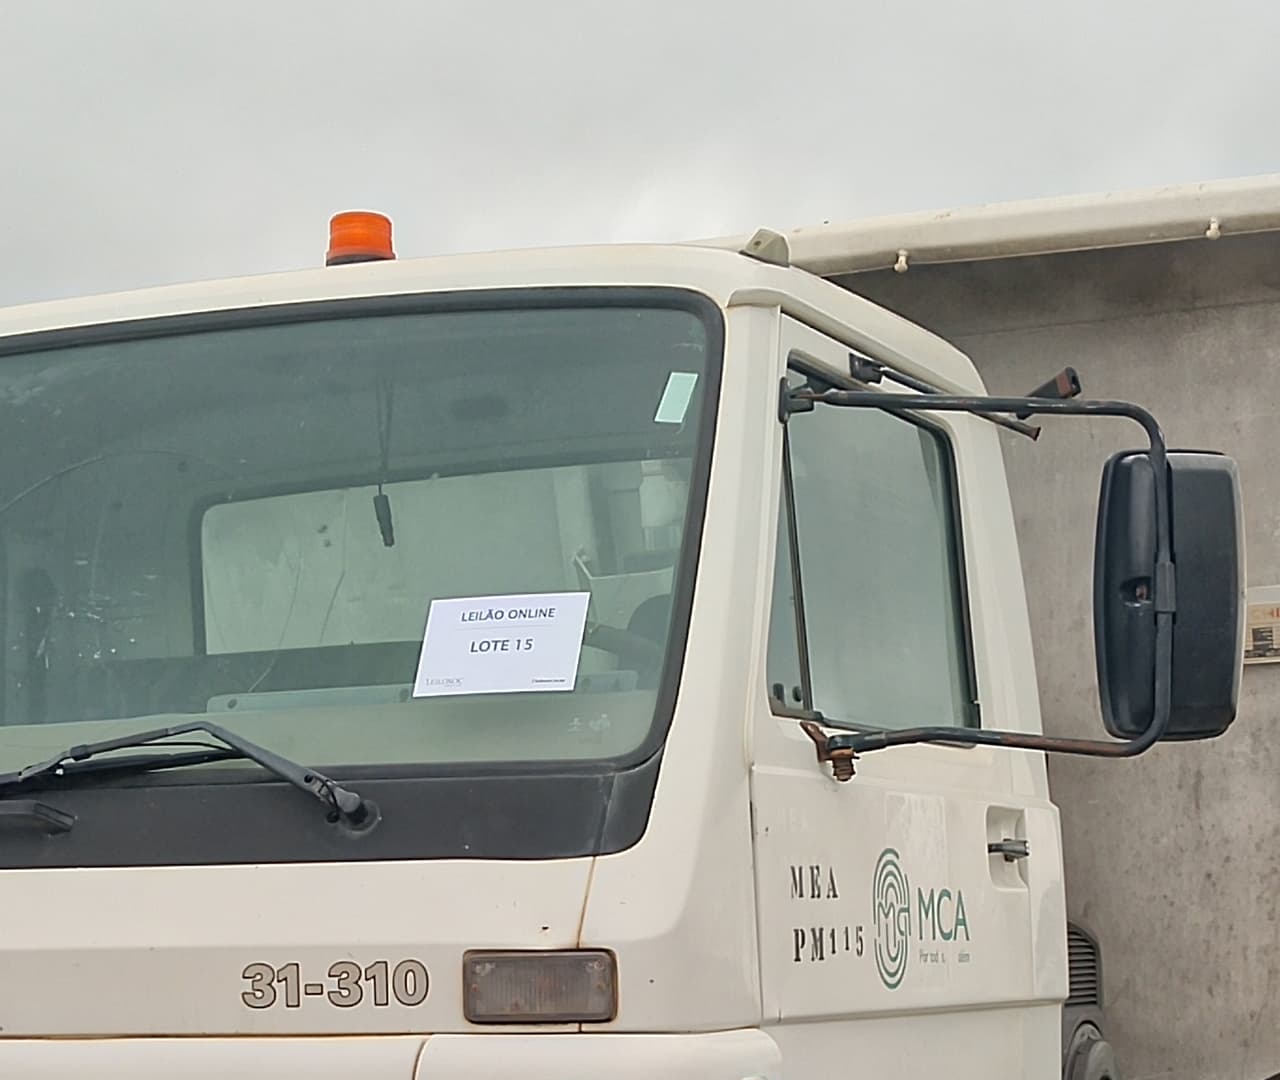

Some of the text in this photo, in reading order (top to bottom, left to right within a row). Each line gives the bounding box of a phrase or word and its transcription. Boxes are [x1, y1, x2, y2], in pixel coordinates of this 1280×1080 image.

[461, 607, 556, 622] LEILÃO ONLINE
[470, 638, 534, 653] LOTE 15
[790, 865, 839, 899] MEA
[917, 886, 970, 941] MCA
[793, 925, 864, 963] PM115
[241, 959, 430, 1009] 31-310
